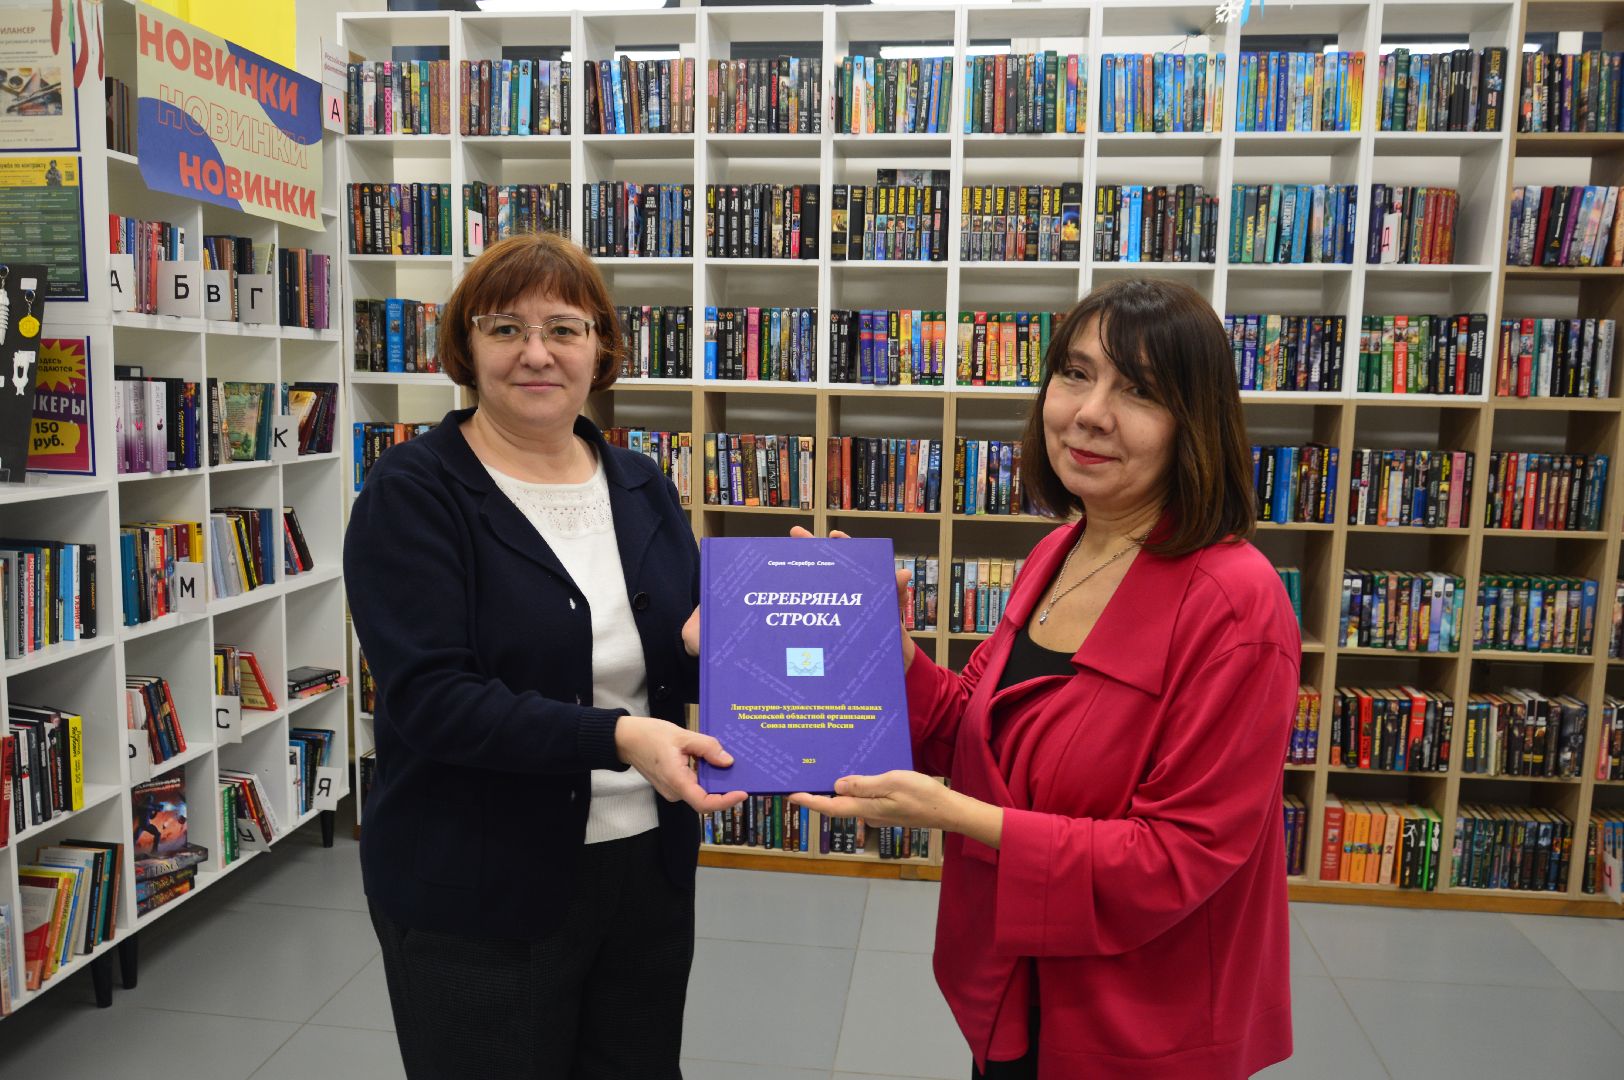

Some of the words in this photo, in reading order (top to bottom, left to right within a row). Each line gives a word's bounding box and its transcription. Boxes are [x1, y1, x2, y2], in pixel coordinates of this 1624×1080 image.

[139, 13, 299, 116] НОВИНКИ
[332, 98, 340, 123] А
[158, 84, 308, 169] НОВИНКИ
[179, 152, 316, 219] НОВИНКИ
[475, 222, 480, 245] Г
[174, 274, 190, 299] Б
[207, 283, 221, 303] В
[250, 287, 263, 309] Г
[35, 422, 59, 433] 150
[274, 427, 288, 448] К
[33, 435, 64, 450] руб.
[180, 577, 195, 598] М
[744, 592, 863, 605] СЕРЕБРЯНАЯ
[766, 612, 841, 626] СТРОКА
[216, 709, 230, 728] С
[316, 778, 332, 797] Я
